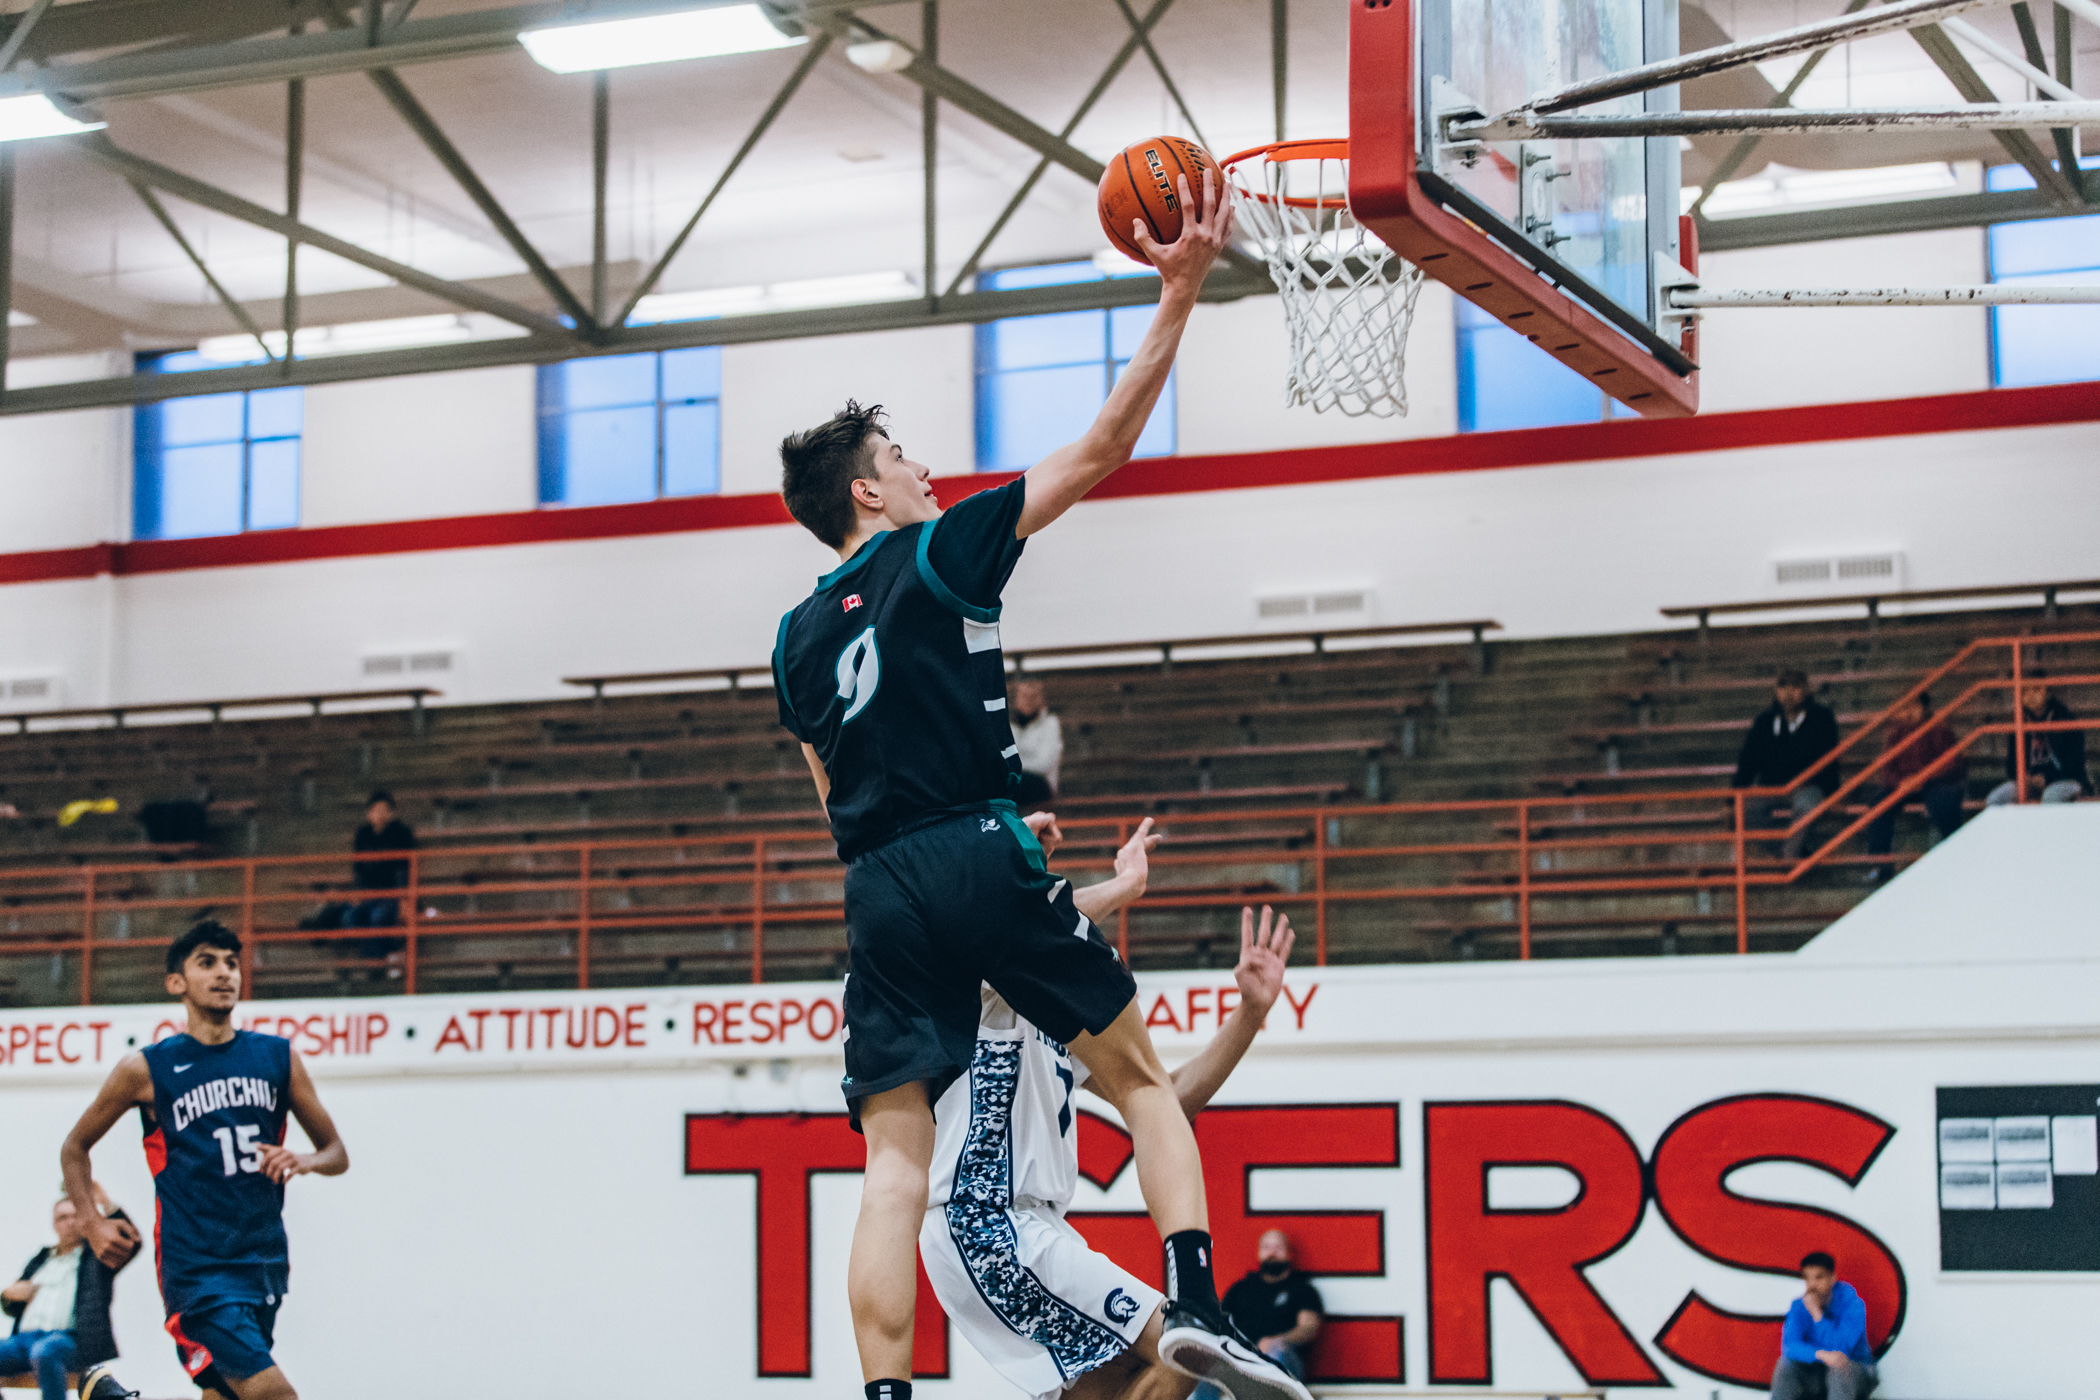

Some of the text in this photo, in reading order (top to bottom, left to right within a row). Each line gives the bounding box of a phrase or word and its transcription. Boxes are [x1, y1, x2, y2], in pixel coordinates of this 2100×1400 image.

[1144, 149, 1180, 214] ELITE
[834, 624, 883, 726] 9
[0, 982, 1320, 1065] PECT RSHIP ATTITUDE RESPO AFEY
[212, 1123, 264, 1177] 15
[684, 1092, 1906, 1390] TERS
